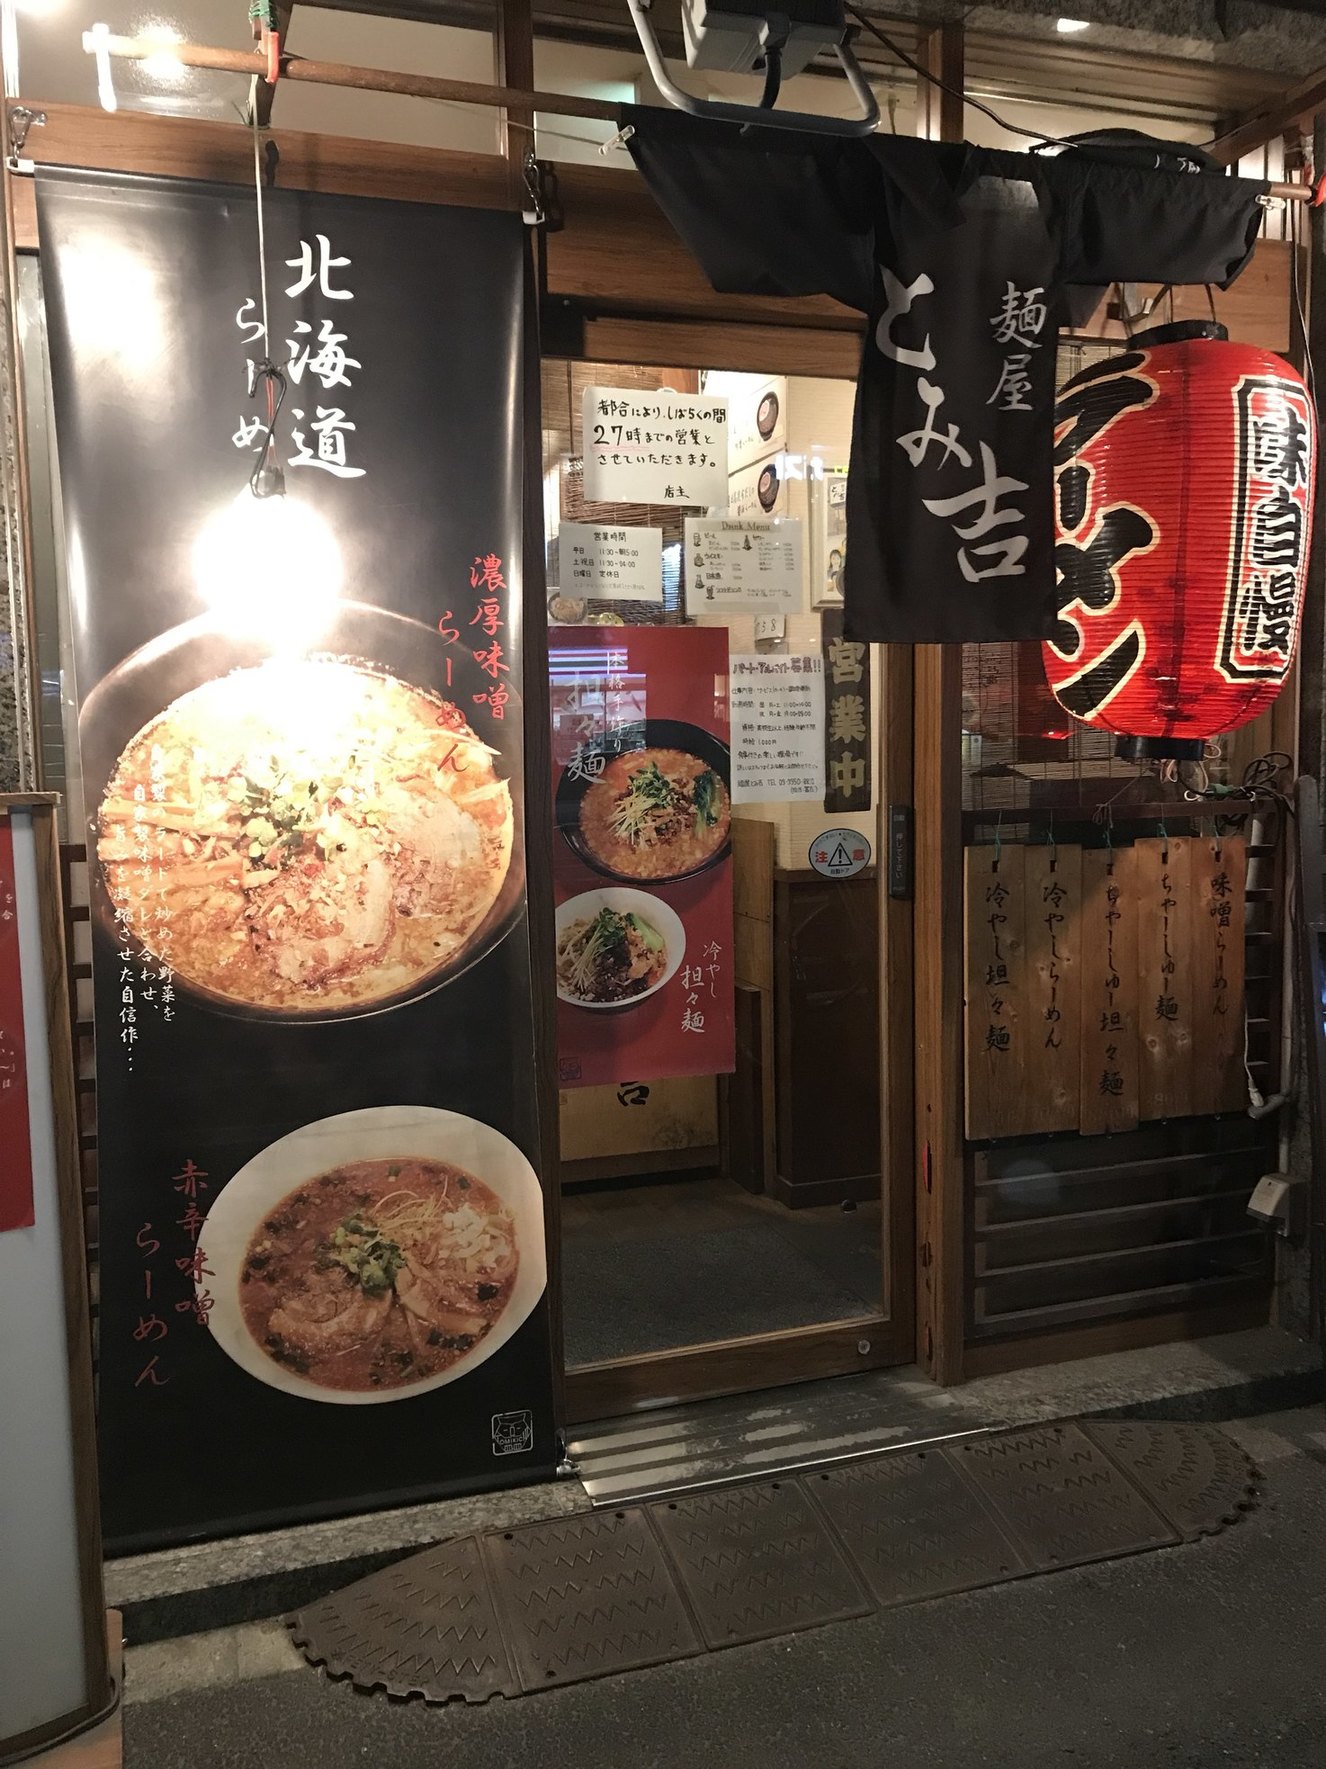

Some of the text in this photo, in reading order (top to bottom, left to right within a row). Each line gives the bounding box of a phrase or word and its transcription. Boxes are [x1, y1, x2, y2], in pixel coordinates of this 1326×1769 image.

[232, 298, 274, 453] らーめ
[284, 234, 367, 478] 北海道
[986, 280, 1048, 411] 麺屋
[593, 425, 715, 446] 27時までの営業と
[598, 453, 716, 467] させていただきます。
[664, 485, 690, 499] 店主
[875, 263, 1030, 583] とみ吉
[593, 531, 627, 543] 営業時間
[599, 570, 619, 578] 定休日
[1240, 400, 1309, 658] 味自慢
[435, 610, 469, 773] らーめん
[468, 553, 510, 720] 濃厚味噌
[680, 965, 705, 1033] 担々麺
[702, 940, 723, 999] 冷やし
[1043, 882, 1067, 1049] 冷やしらーめん
[1210, 872, 1233, 1015] 味噌らーめん
[132, 1222, 169, 1388] らーめん
[171, 1158, 216, 1326] 赤辛味噌
